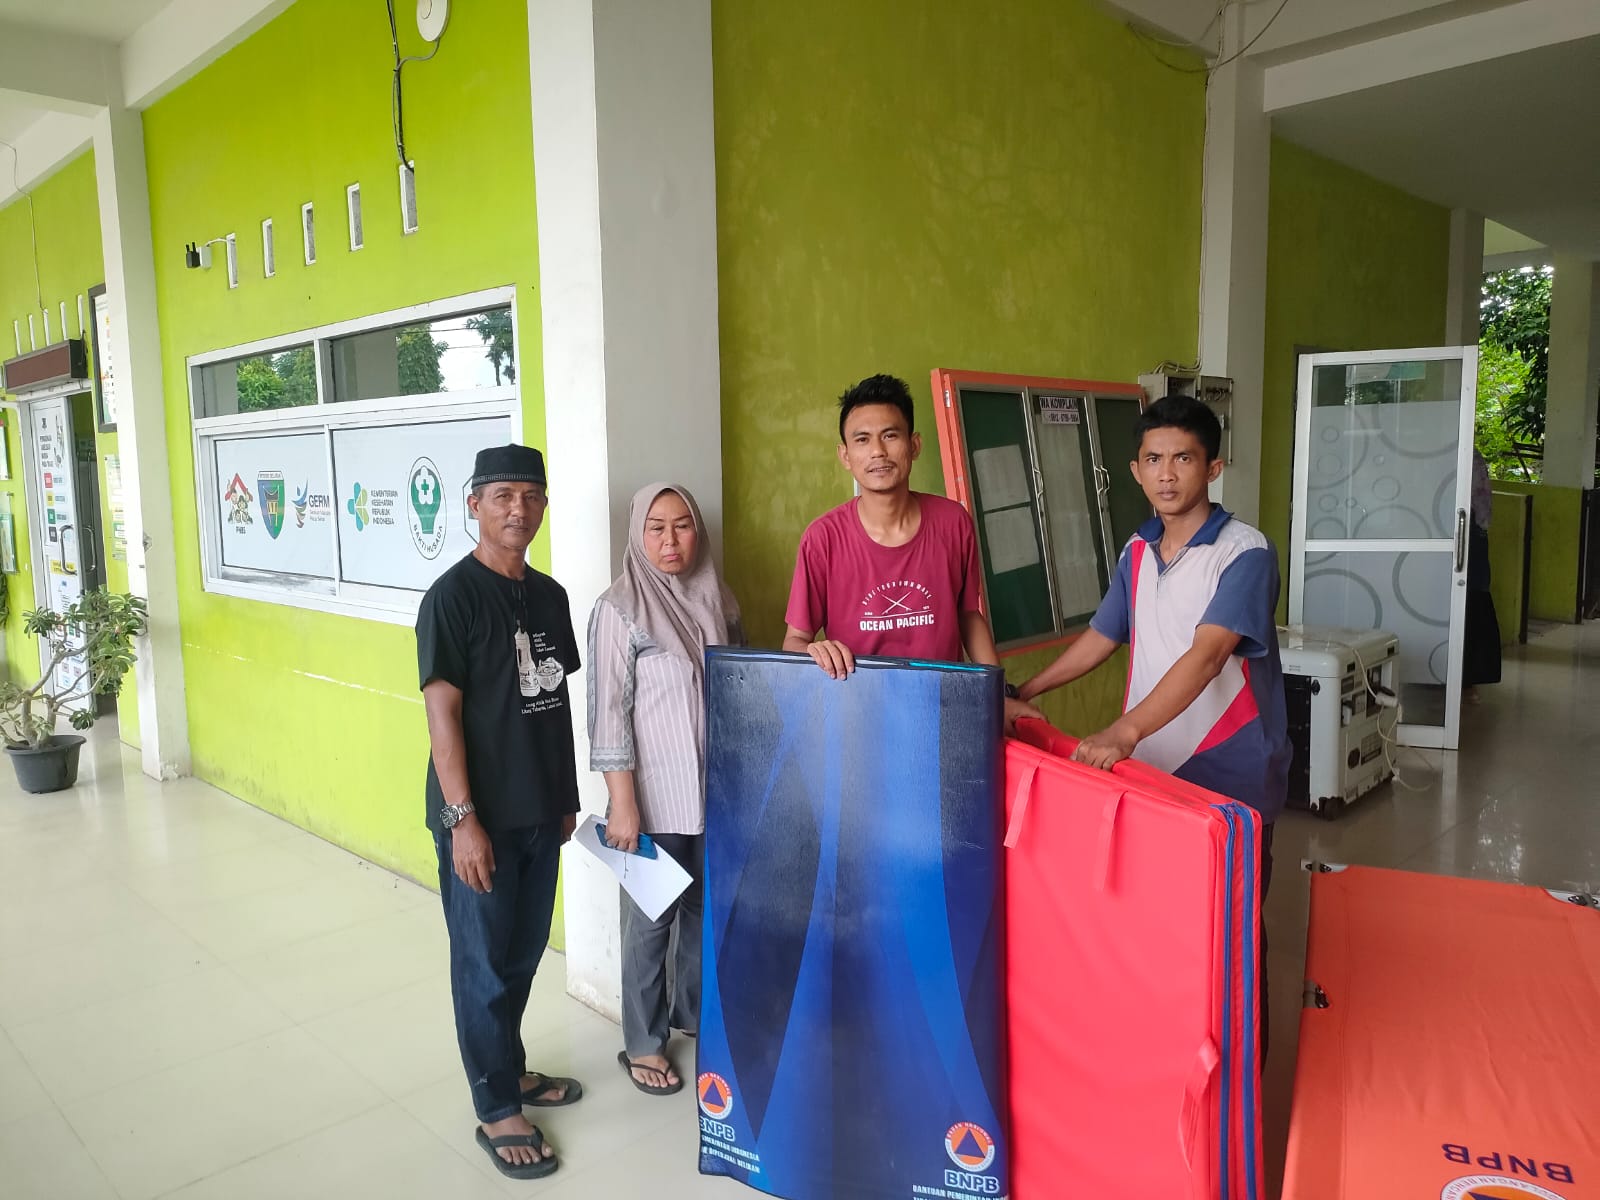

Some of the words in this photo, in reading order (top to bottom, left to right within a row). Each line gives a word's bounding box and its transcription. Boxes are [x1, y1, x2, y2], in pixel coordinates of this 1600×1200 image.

[371, 499, 394, 507] KESEHATAN
[373, 517, 395, 525] INDONESIA
[860, 619, 893, 631] OCEAN
[896, 614, 934, 629] PACIFIC
[700, 1117, 735, 1141] BNPB
[1441, 1143, 1575, 1184] BNPB
[945, 1169, 999, 1193] BNPB
